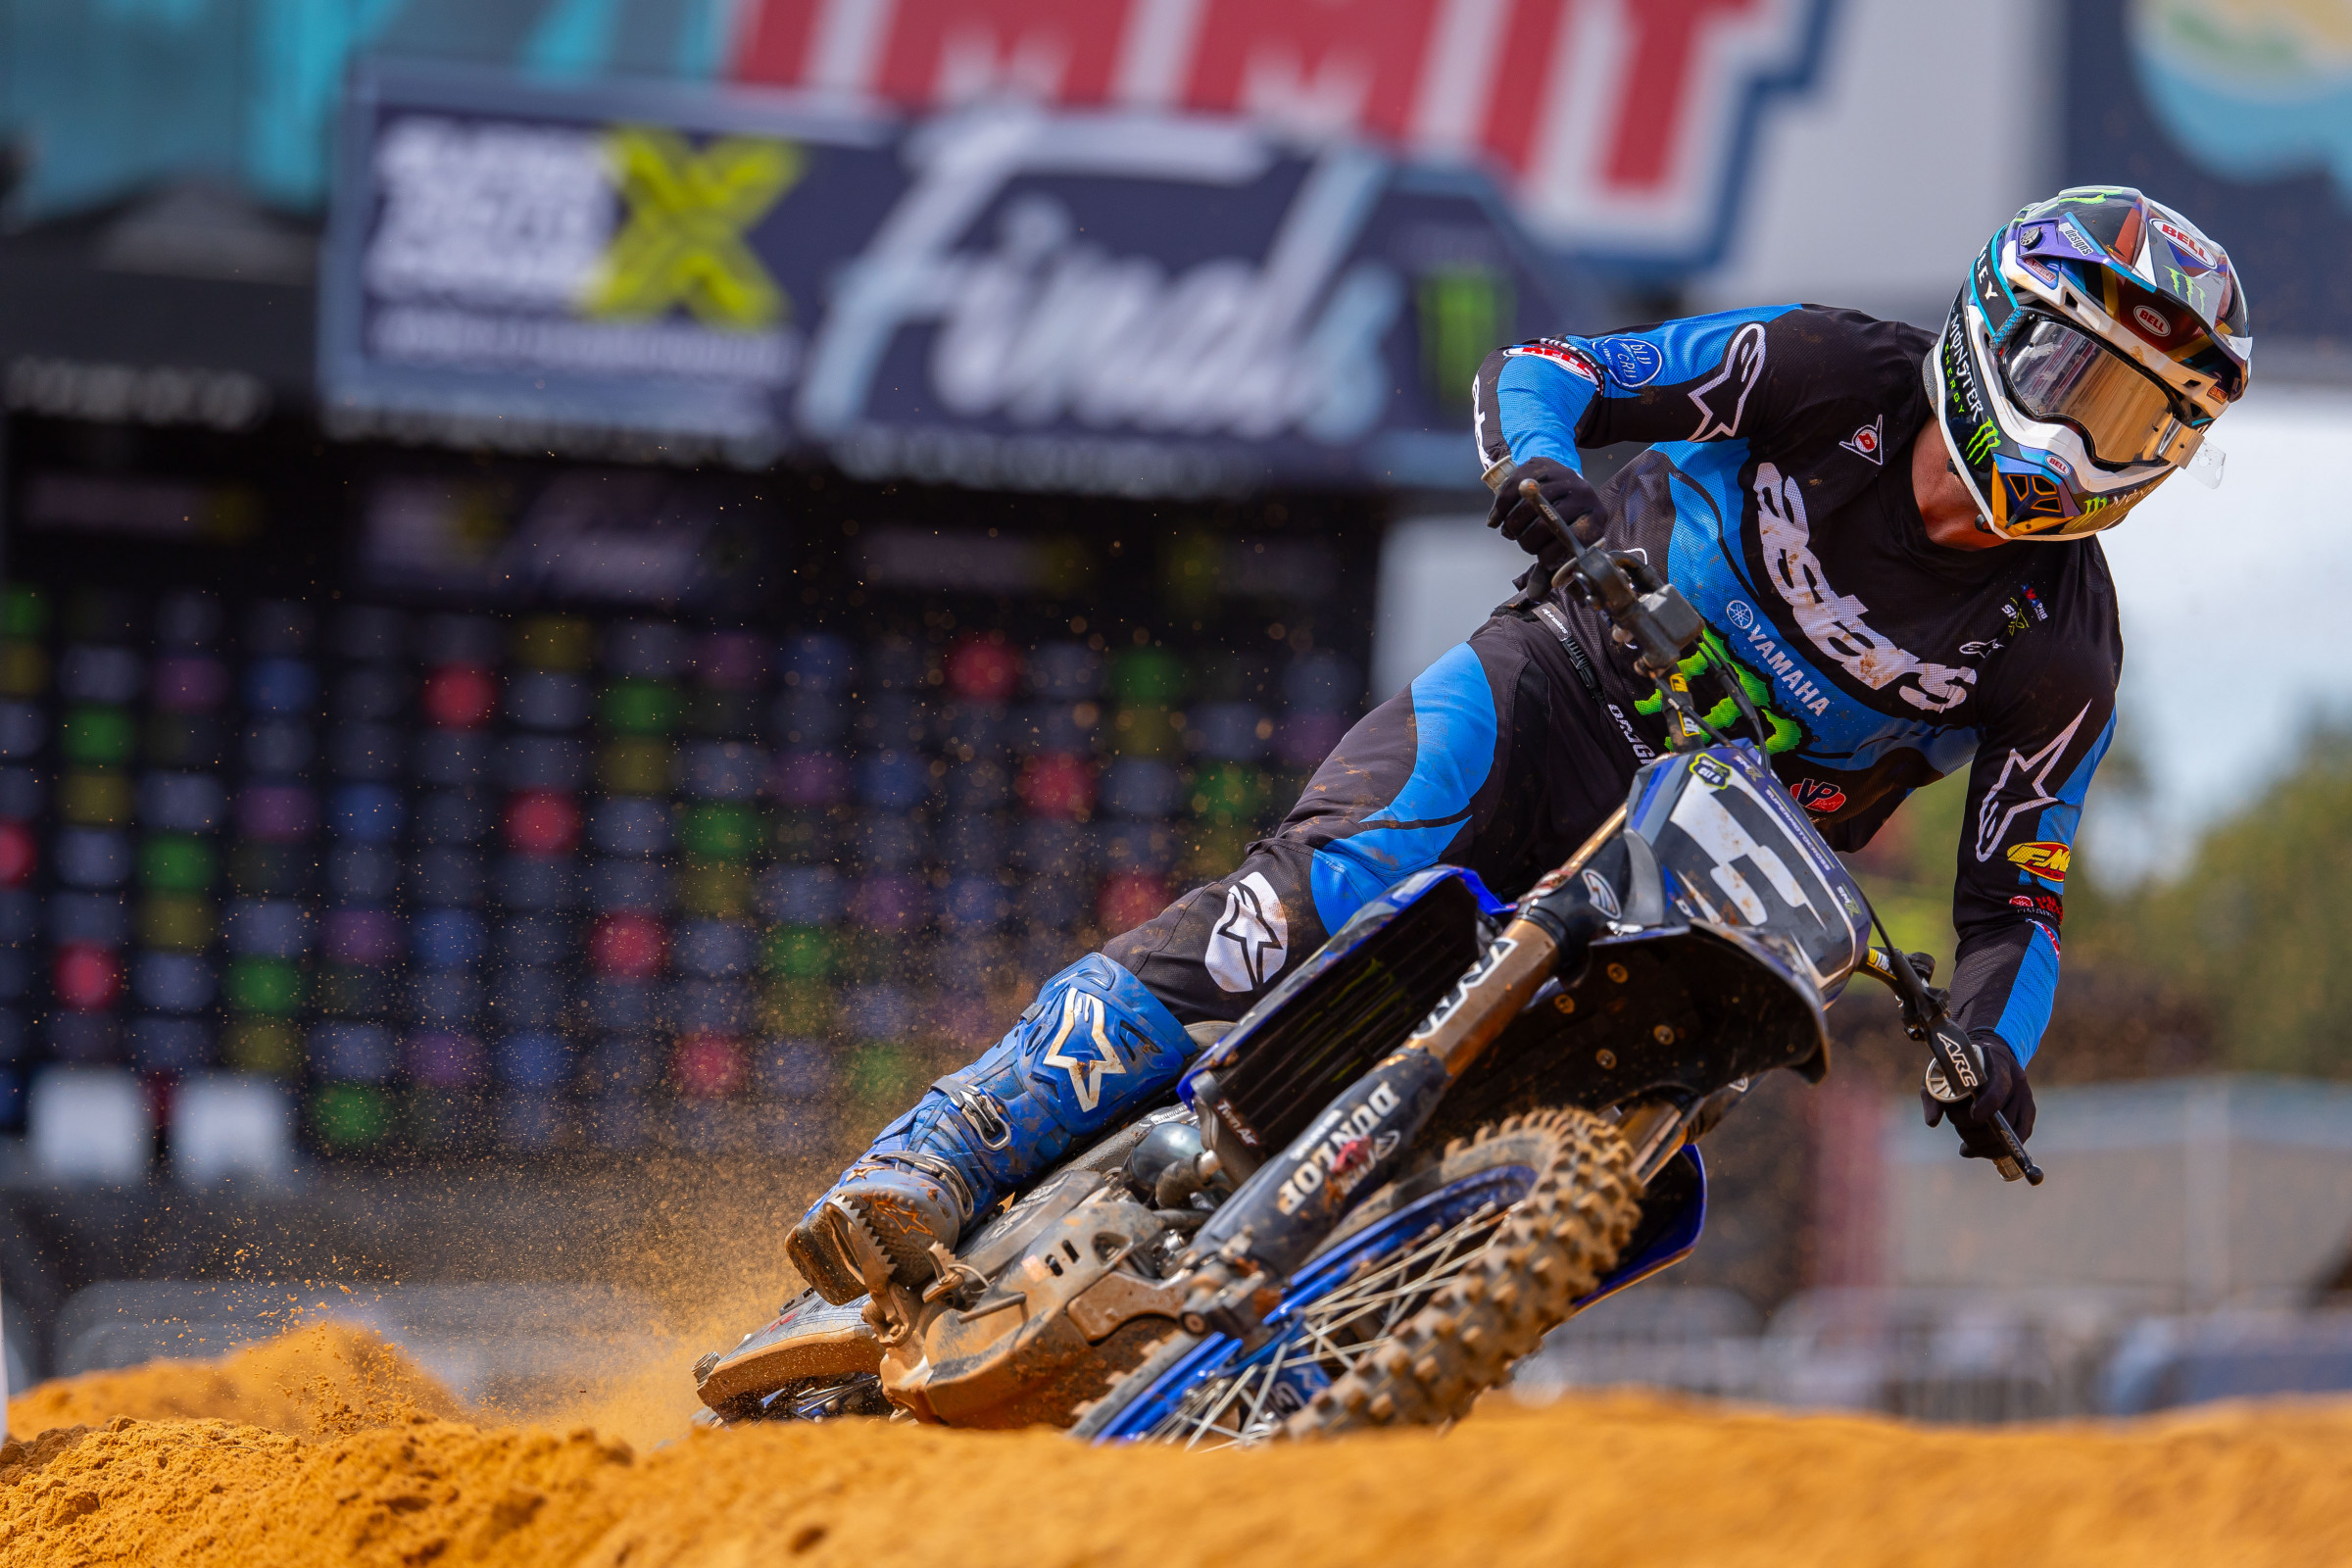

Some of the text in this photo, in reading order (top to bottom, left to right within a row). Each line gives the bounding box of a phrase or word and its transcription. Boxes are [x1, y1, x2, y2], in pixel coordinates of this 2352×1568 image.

[2162, 223, 2209, 262] BELL
[2139, 309, 2165, 333] BELL
[1944, 343, 1965, 413] ENERGY
[1949, 314, 1984, 422] MONSTER
[2048, 457, 2068, 475] BELL
[1748, 623, 1831, 717] YAMAHA
[1796, 778, 1840, 808] VP
[1764, 788, 1831, 872] SUPERMOTOCROSS
[2007, 845, 2071, 873] FM
[1936, 1032, 1979, 1088] ARC
[1277, 1080, 1402, 1216] DUNLOP
